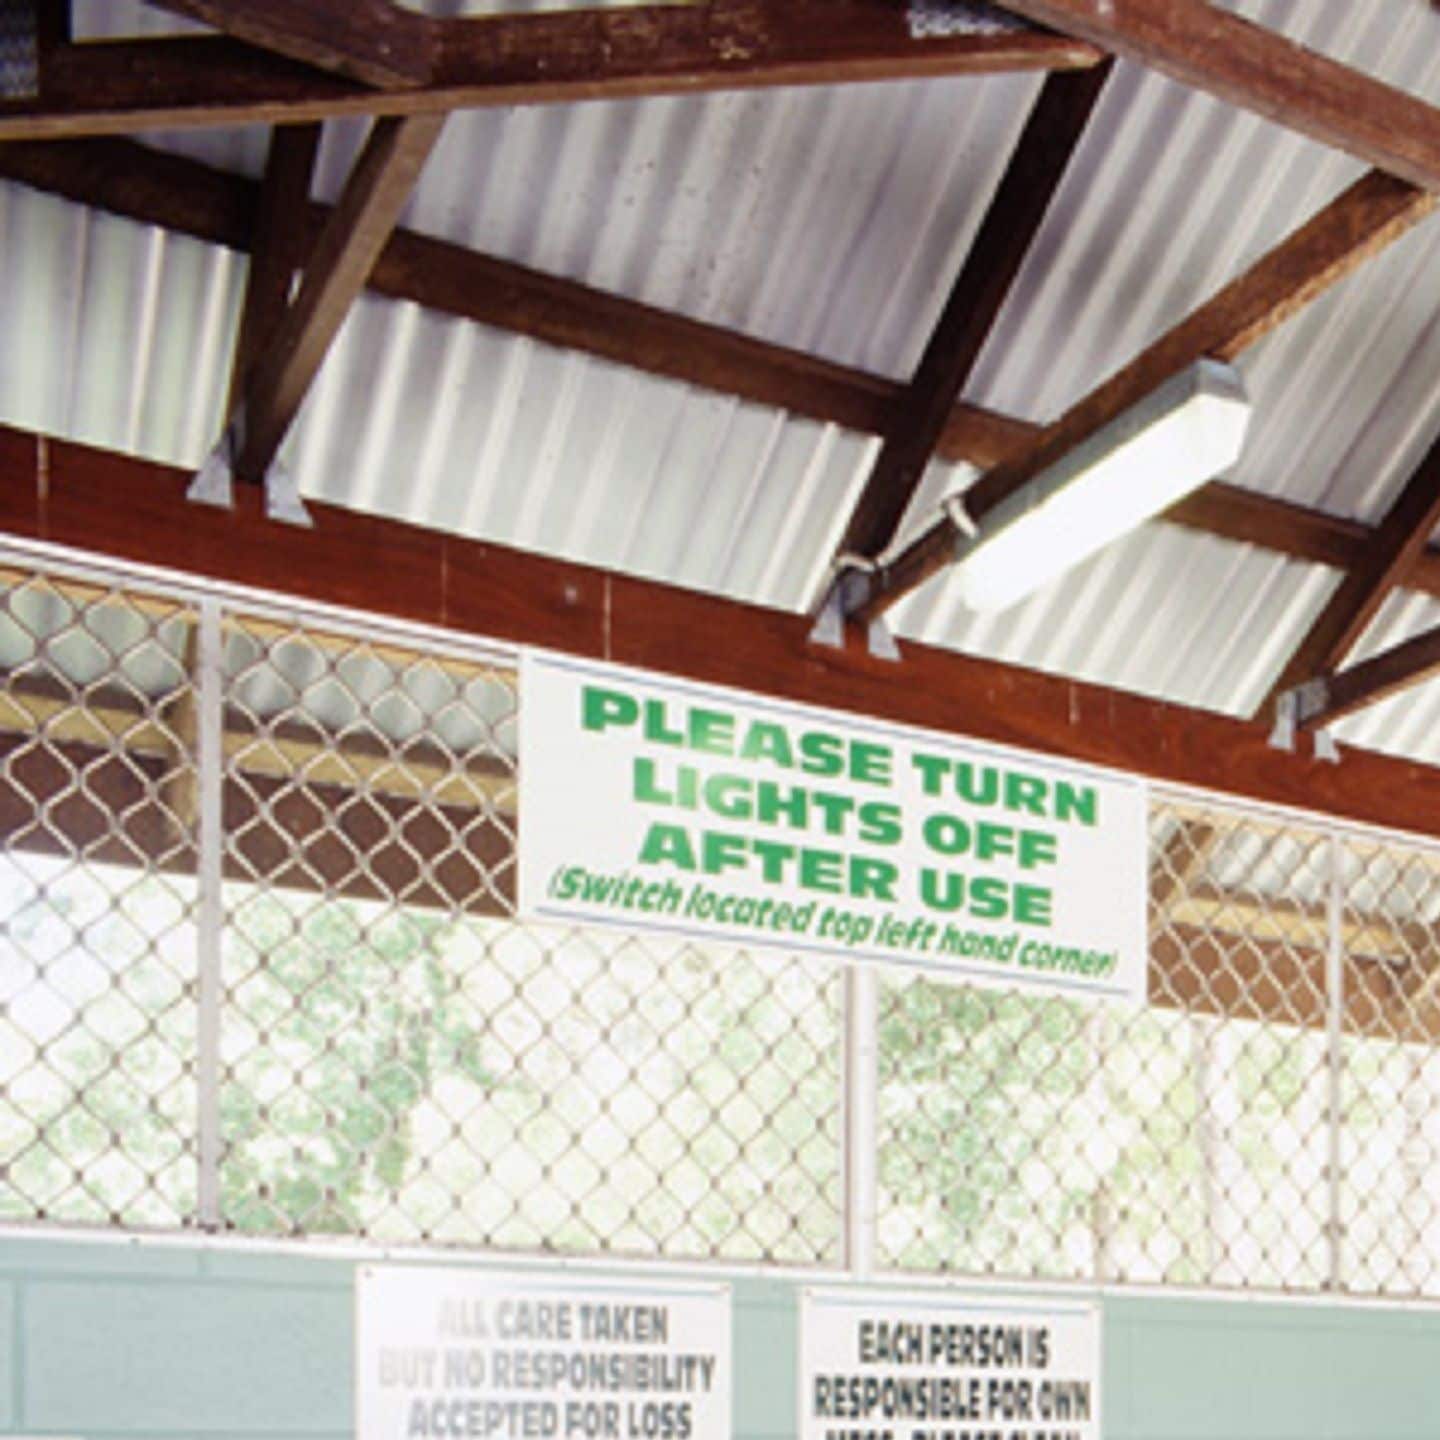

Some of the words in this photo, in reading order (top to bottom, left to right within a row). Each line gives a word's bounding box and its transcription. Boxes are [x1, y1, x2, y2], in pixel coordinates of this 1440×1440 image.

[581, 686, 893, 786] PLEASE
[911, 753, 1097, 825] TURN
[632, 757, 903, 845] LIGHTS
[922, 813, 1056, 870] OFF
[638, 822, 898, 903] AFTER
[920, 869, 1052, 926] USE
[548, 864, 681, 915] (Switch
[686, 881, 813, 934] located
[818, 905, 871, 948] top
[877, 911, 936, 952] left
[939, 919, 1009, 963] hand
[1017, 941, 1118, 978] corner)
[438, 1299, 489, 1337] ALL
[497, 1301, 571, 1339] CARE
[580, 1306, 667, 1341] TAKEN
[859, 1320, 923, 1364] EACH
[930, 1324, 1022, 1366] PERSON
[1027, 1327, 1048, 1368] IS
[379, 1348, 435, 1386] BUT
[444, 1350, 484, 1387] NO
[493, 1352, 715, 1392] RESPONSIBILITY
[408, 1401, 558, 1439] ACCEPTED
[566, 1403, 619, 1439] FOR
[628, 1403, 692, 1440] LOSS
[815, 1374, 980, 1419] RESPONSIBLE
[988, 1378, 1032, 1419] FOR
[1037, 1380, 1091, 1421] OWN
